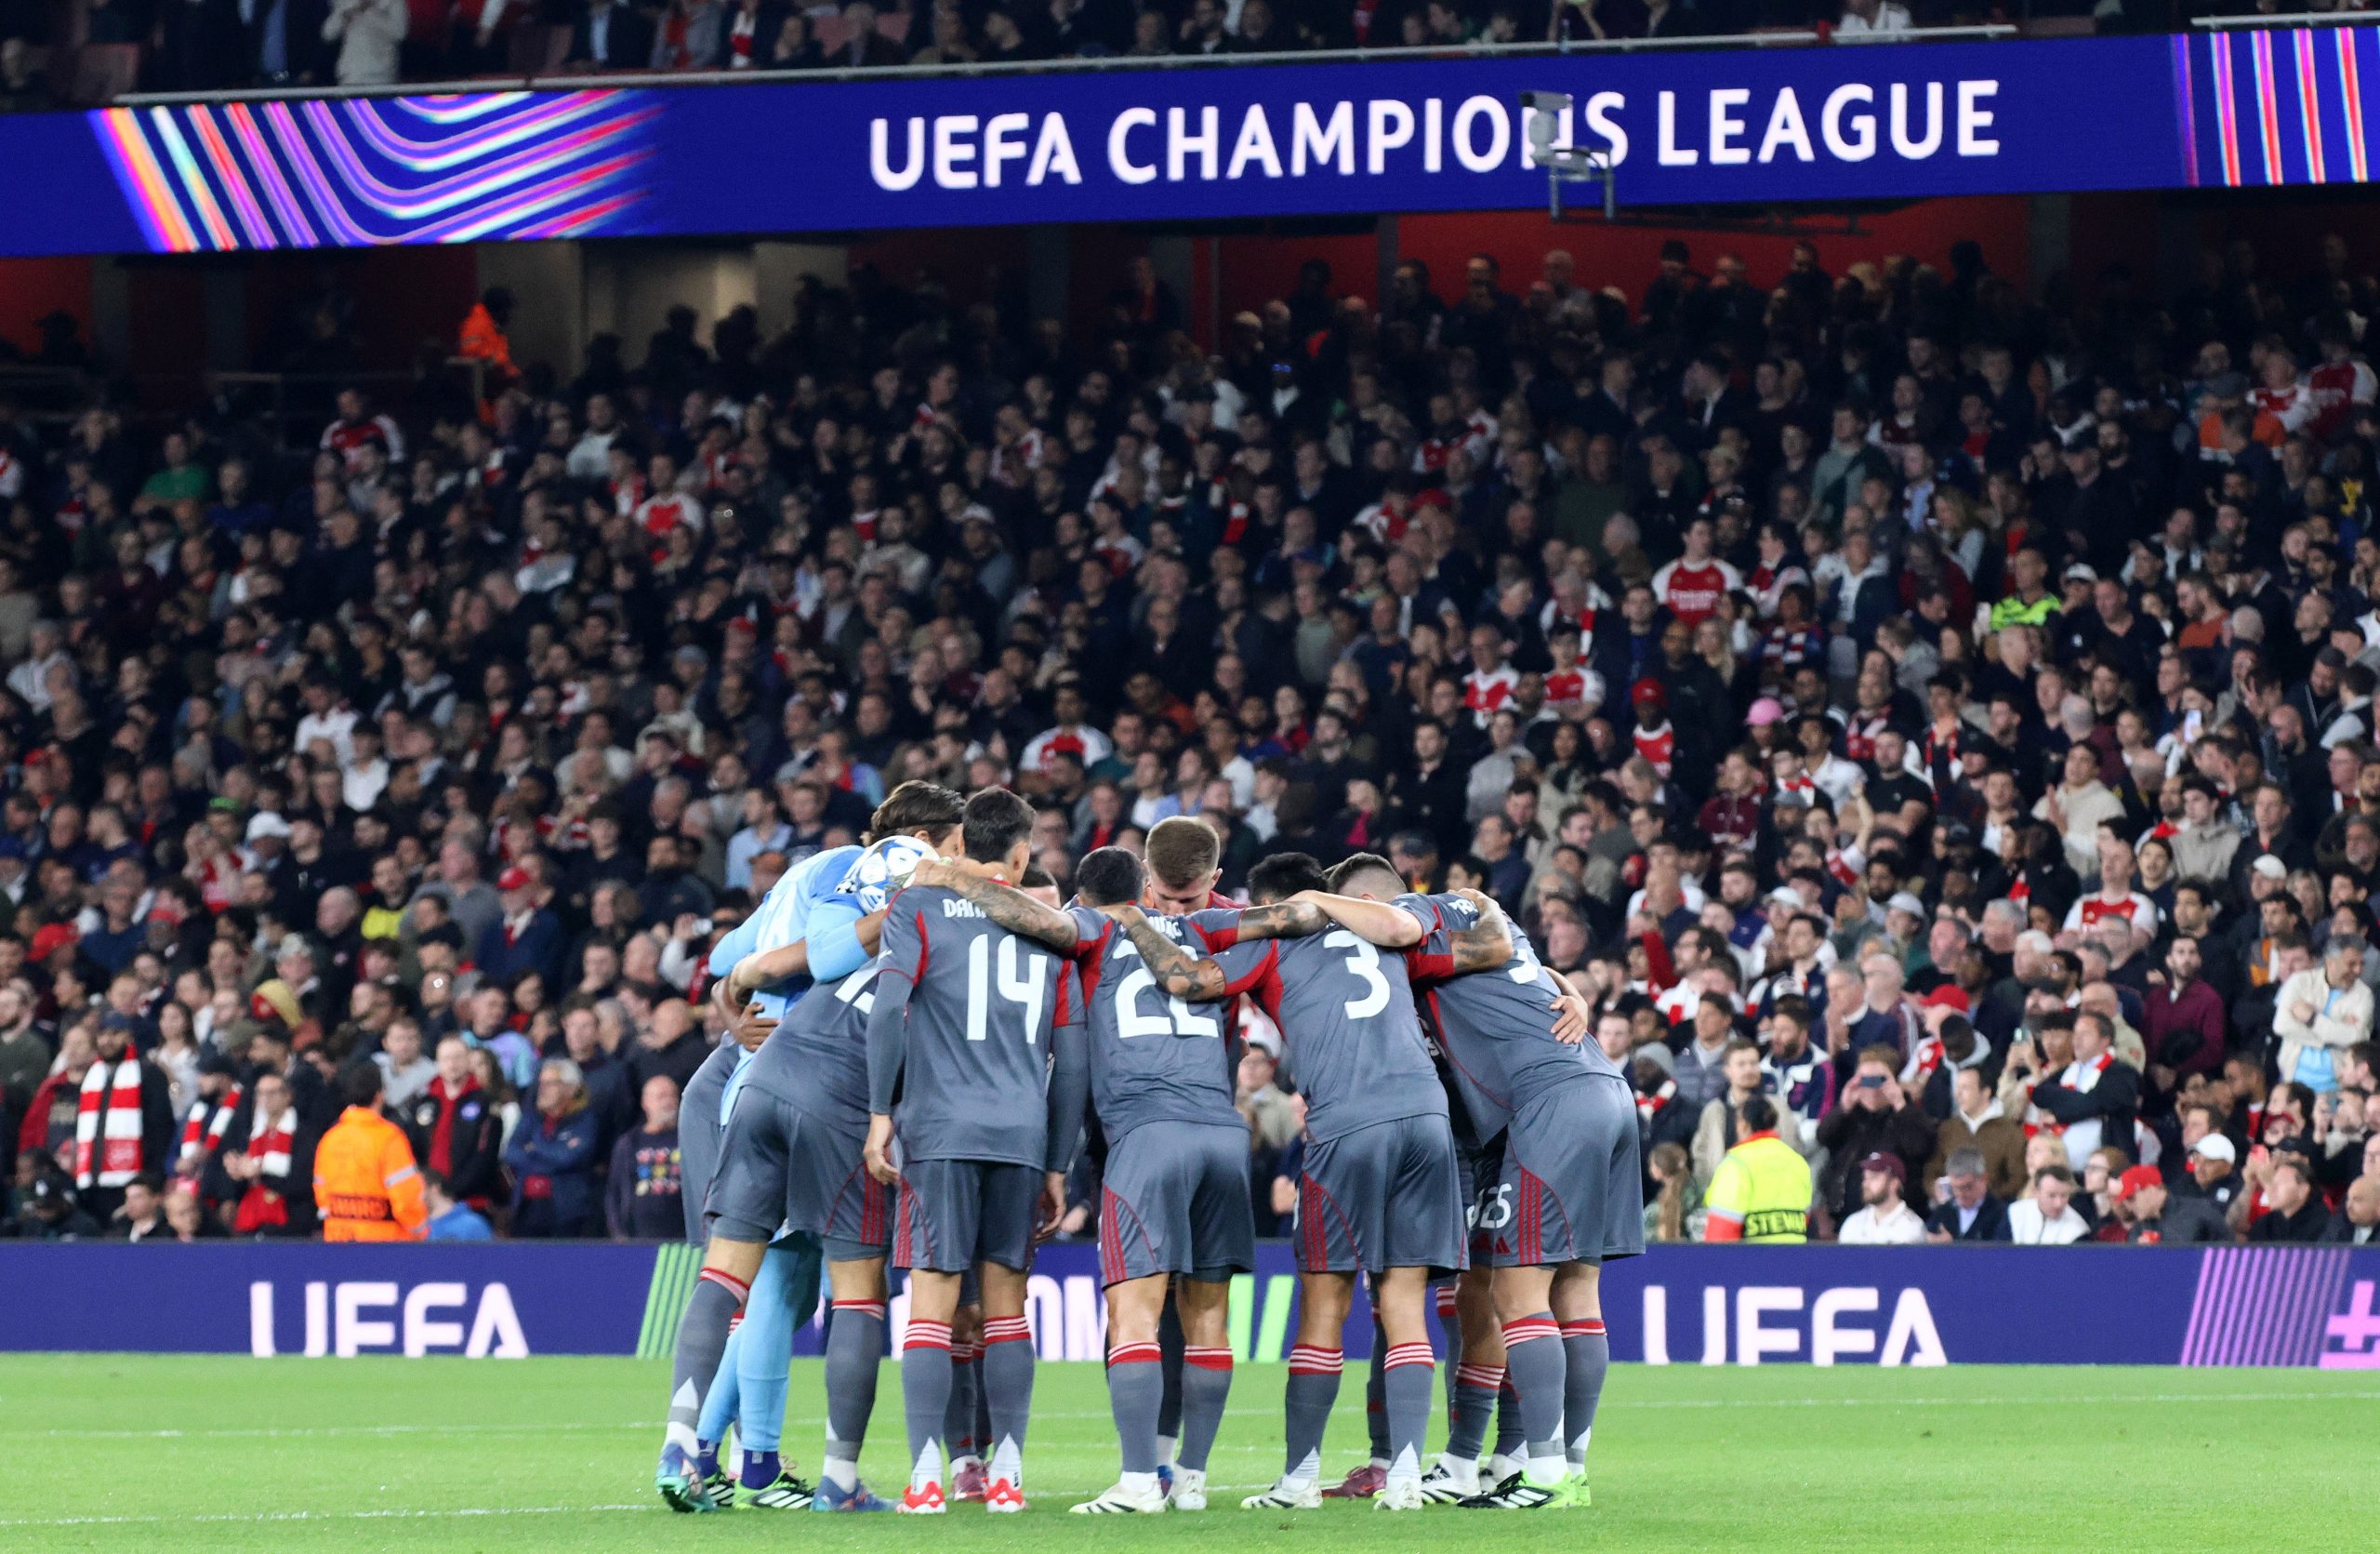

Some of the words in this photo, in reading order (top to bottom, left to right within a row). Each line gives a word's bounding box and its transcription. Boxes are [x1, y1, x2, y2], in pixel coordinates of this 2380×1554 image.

[870, 112, 1082, 192] UEFA
[1658, 79, 2000, 166] LEAGUE
[966, 933, 1048, 1045] 14
[1323, 930, 1391, 1020] 3
[250, 1282, 530, 1359] UEFA
[1643, 1285, 1949, 1365] UEFA
